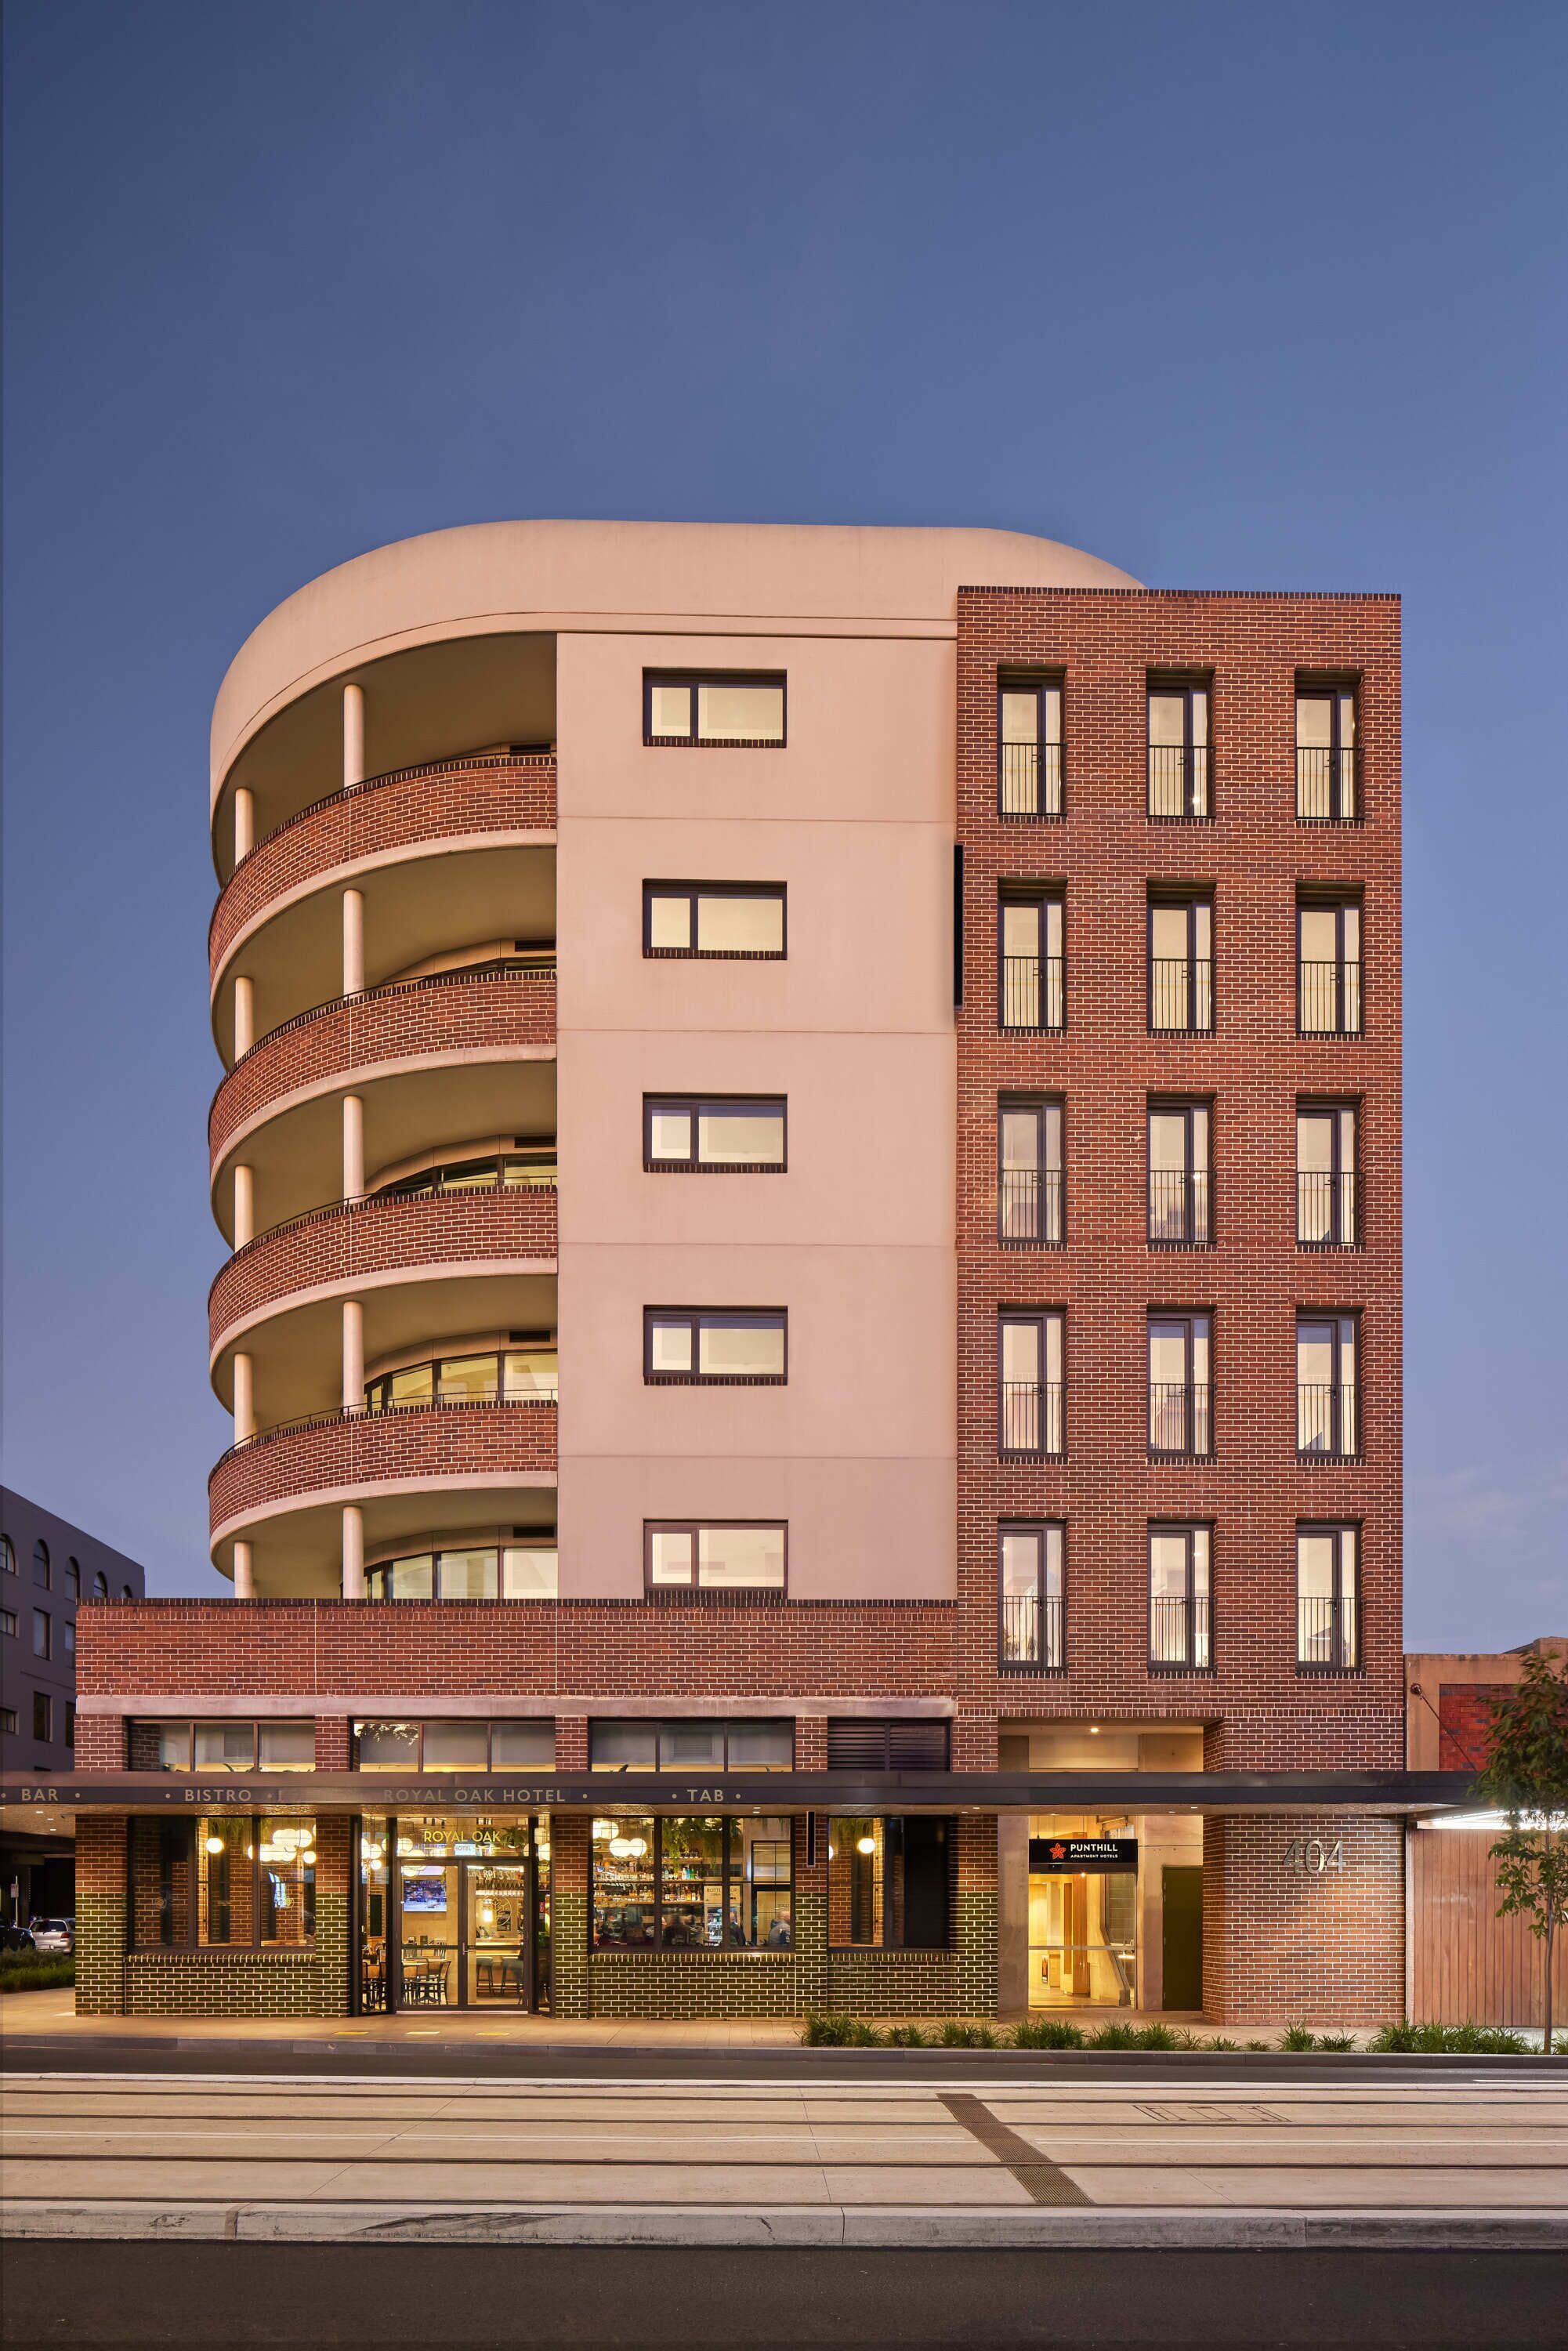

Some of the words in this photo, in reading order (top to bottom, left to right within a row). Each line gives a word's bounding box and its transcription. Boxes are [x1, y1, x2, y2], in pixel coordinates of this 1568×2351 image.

[21, 1788, 59, 1801] BAR
[184, 1789, 252, 1802] BISTRO
[384, 1789, 446, 1802] ROYAL
[454, 1789, 495, 1802] OAK
[503, 1789, 566, 1802] HOTEL
[686, 1789, 724, 1802] TAB
[424, 1831, 468, 1842] ROYAL
[472, 1831, 502, 1842] OAK
[1283, 1840, 1347, 1874] 404
